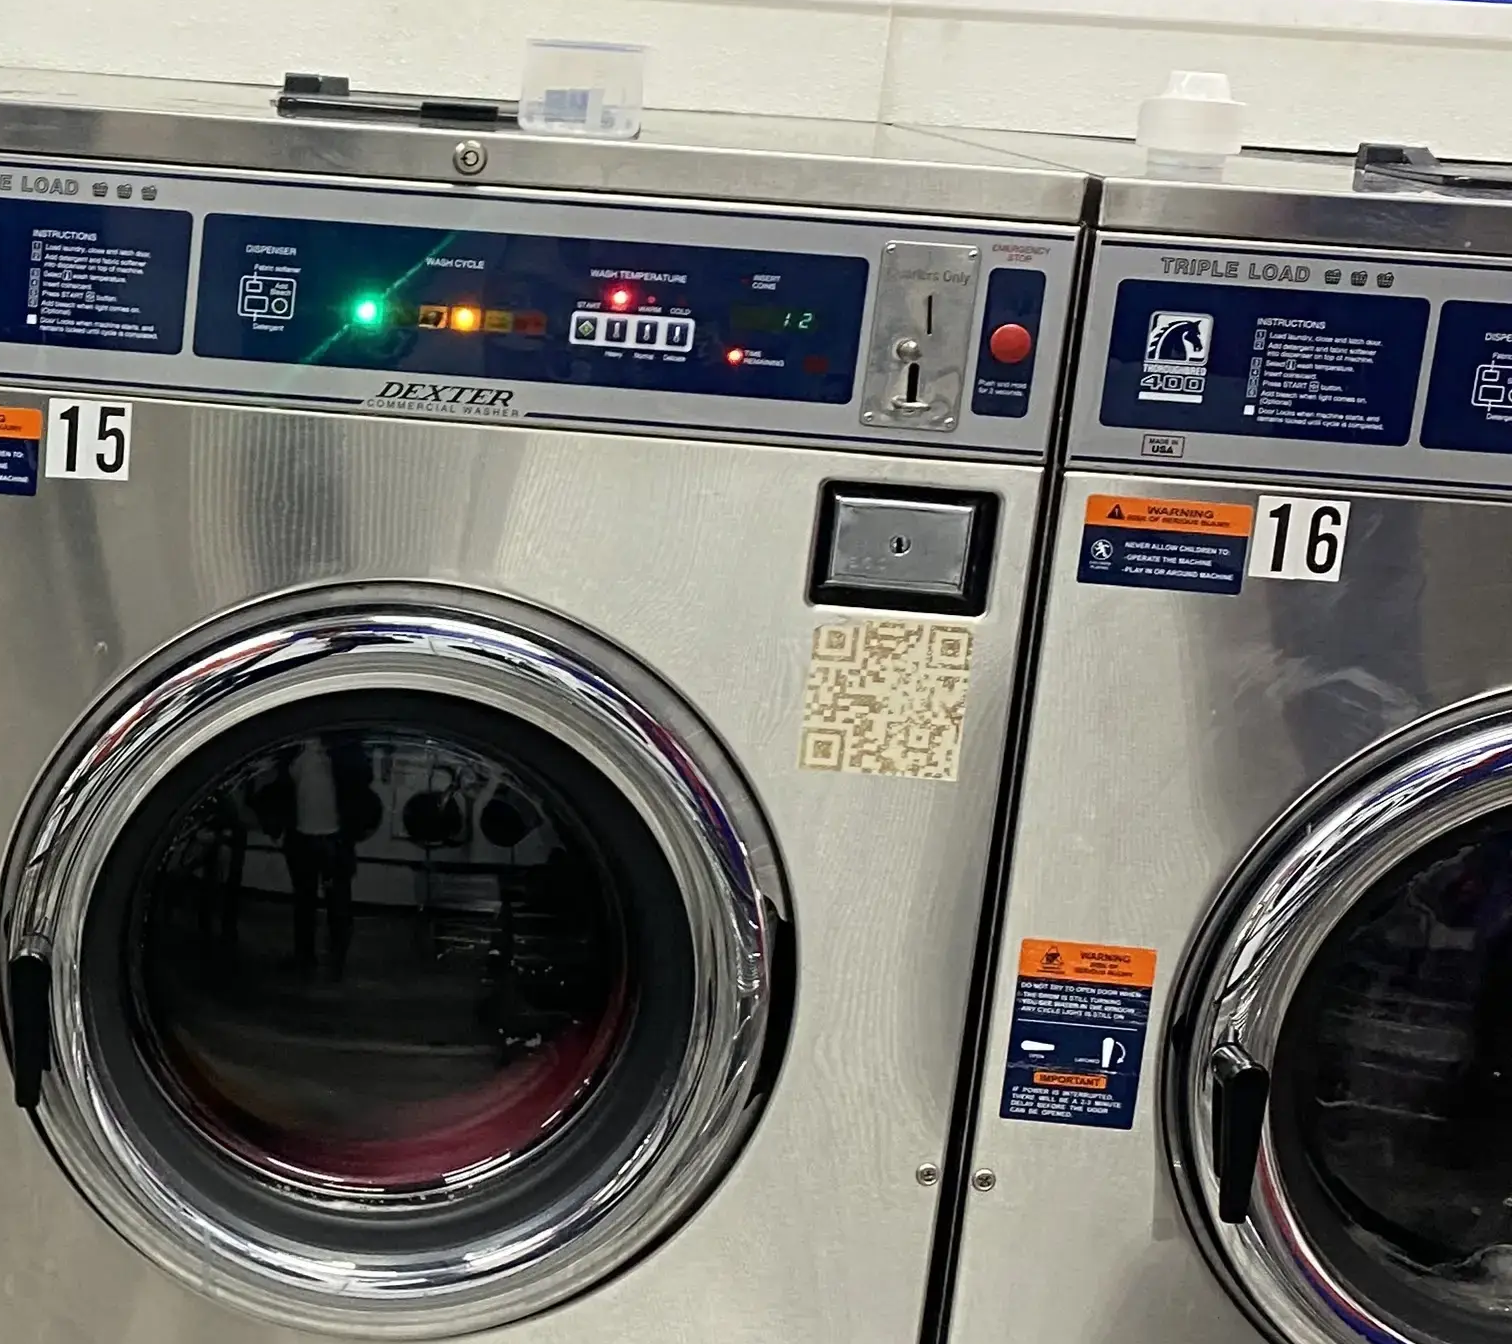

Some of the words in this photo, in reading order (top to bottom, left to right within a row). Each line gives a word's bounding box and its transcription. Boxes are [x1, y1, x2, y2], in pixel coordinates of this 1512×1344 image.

[22, 175, 80, 196] LOAD
[32, 229, 97, 241] INSTRUCTIONS
[246, 244, 297, 256] DISPENSER
[992, 244, 1051, 255] EMERGENCY
[426, 257, 454, 267] WASH
[455, 259, 485, 270] CYCLE
[1008, 254, 1032, 262] STOP
[1160, 257, 1240, 278] TRIPLE
[1248, 263, 1311, 283] LOAD
[590, 269, 619, 279] WASH
[620, 270, 687, 284] TEMPERATURE
[943, 270, 971, 286] Only
[782, 312, 813, 330] 12
[1257, 318, 1326, 330] INSTRUCTIONS
[1143, 364, 1207, 376] THOROUGHBRED
[1140, 374, 1205, 393] 400
[376, 381, 514, 407] DEXTER
[366, 399, 456, 414] COMMERCIAL
[463, 406, 519, 417] WASHER
[59, 406, 126, 473] 15
[1151, 444, 1174, 454] USA
[1147, 506, 1214, 519] WARNING
[1269, 504, 1341, 574] 16
[1179, 545, 1217, 554] CHILDREN
[1179, 558, 1212, 567] MACHINE
[1200, 572, 1234, 580] MACHINE
[1080, 951, 1131, 963] WARNING
[1039, 1074, 1100, 1086] IMPORTANT
